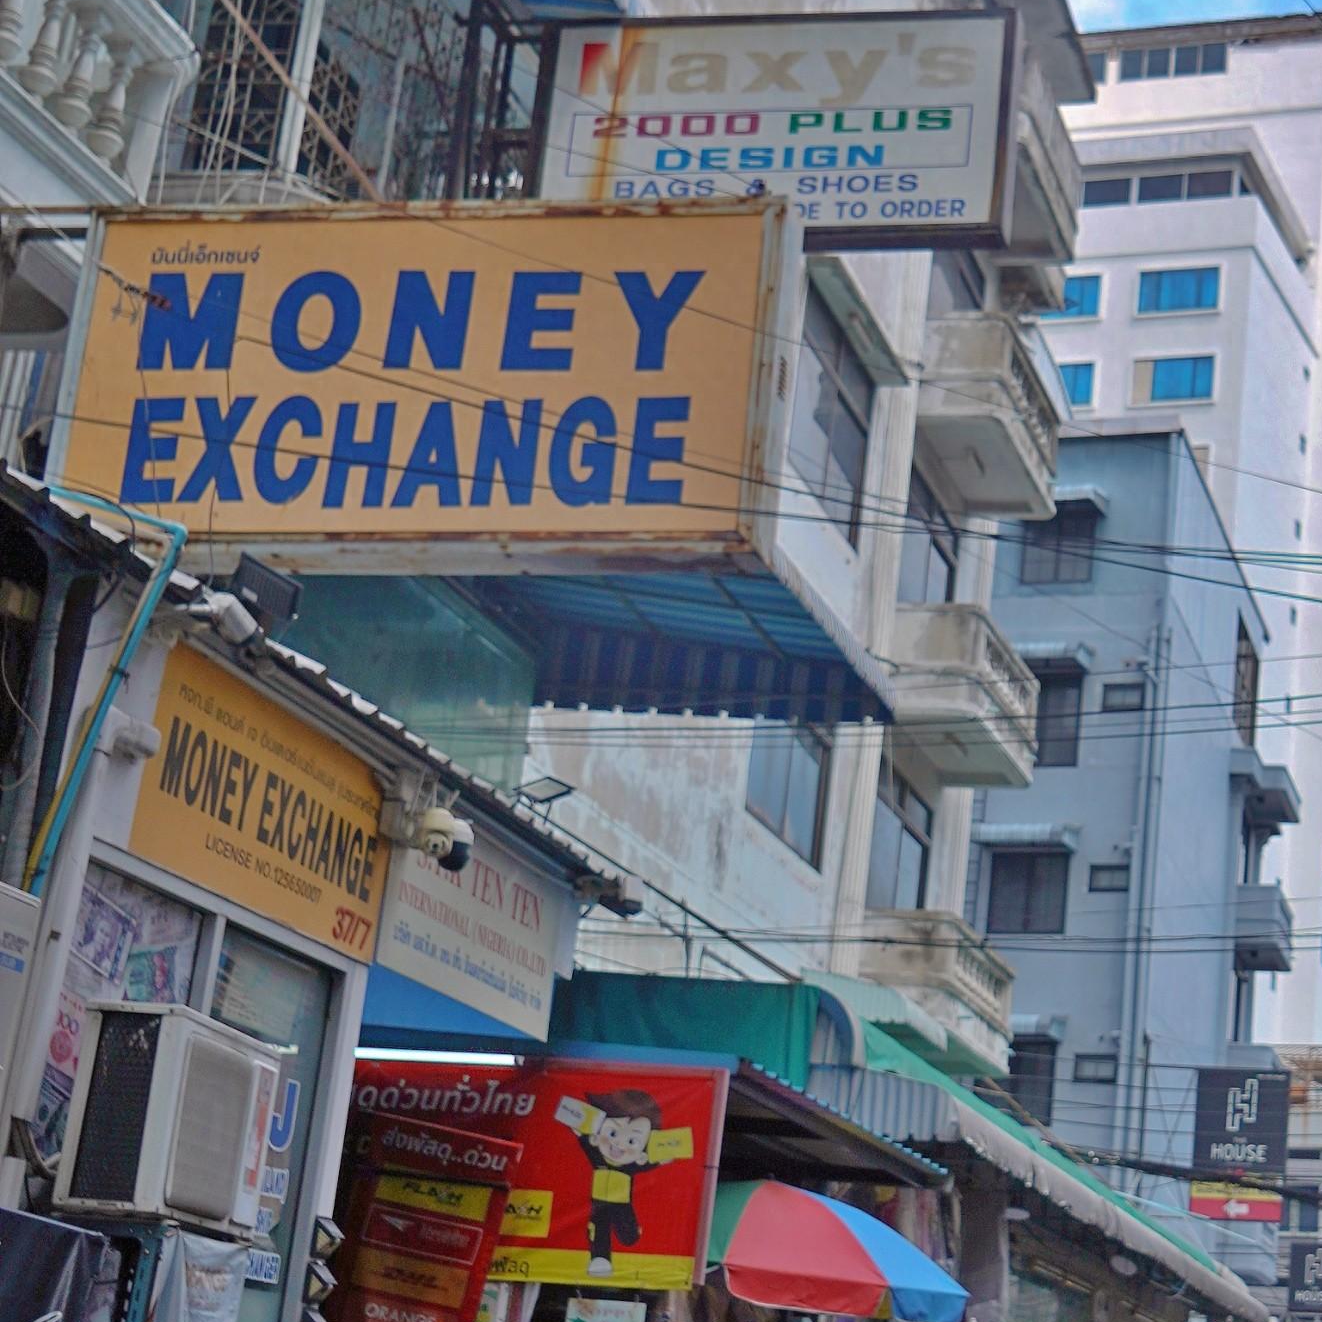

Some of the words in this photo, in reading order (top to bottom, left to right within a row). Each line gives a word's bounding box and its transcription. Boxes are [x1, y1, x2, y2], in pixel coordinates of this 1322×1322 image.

[579, 31, 979, 105] Maxy's
[592, 113, 761, 139] 2000
[788, 107, 954, 135] PLUS
[654, 145, 885, 172] DESIGN
[614, 179, 716, 201] BAGS
[798, 174, 919, 196] SHOES
[837, 201, 868, 220] TO
[881, 199, 966, 219] ORDER
[136, 269, 706, 373] MONEY
[120, 394, 690, 508] EXCHANGE
[160, 715, 259, 832] MONEY
[257, 771, 378, 903] EXCHANGE
[205, 833, 252, 869] LICENSE
[472, 858, 506, 909] TEN
[512, 883, 544, 932] TEN
[1210, 1143, 1268, 1162] HOUSE
